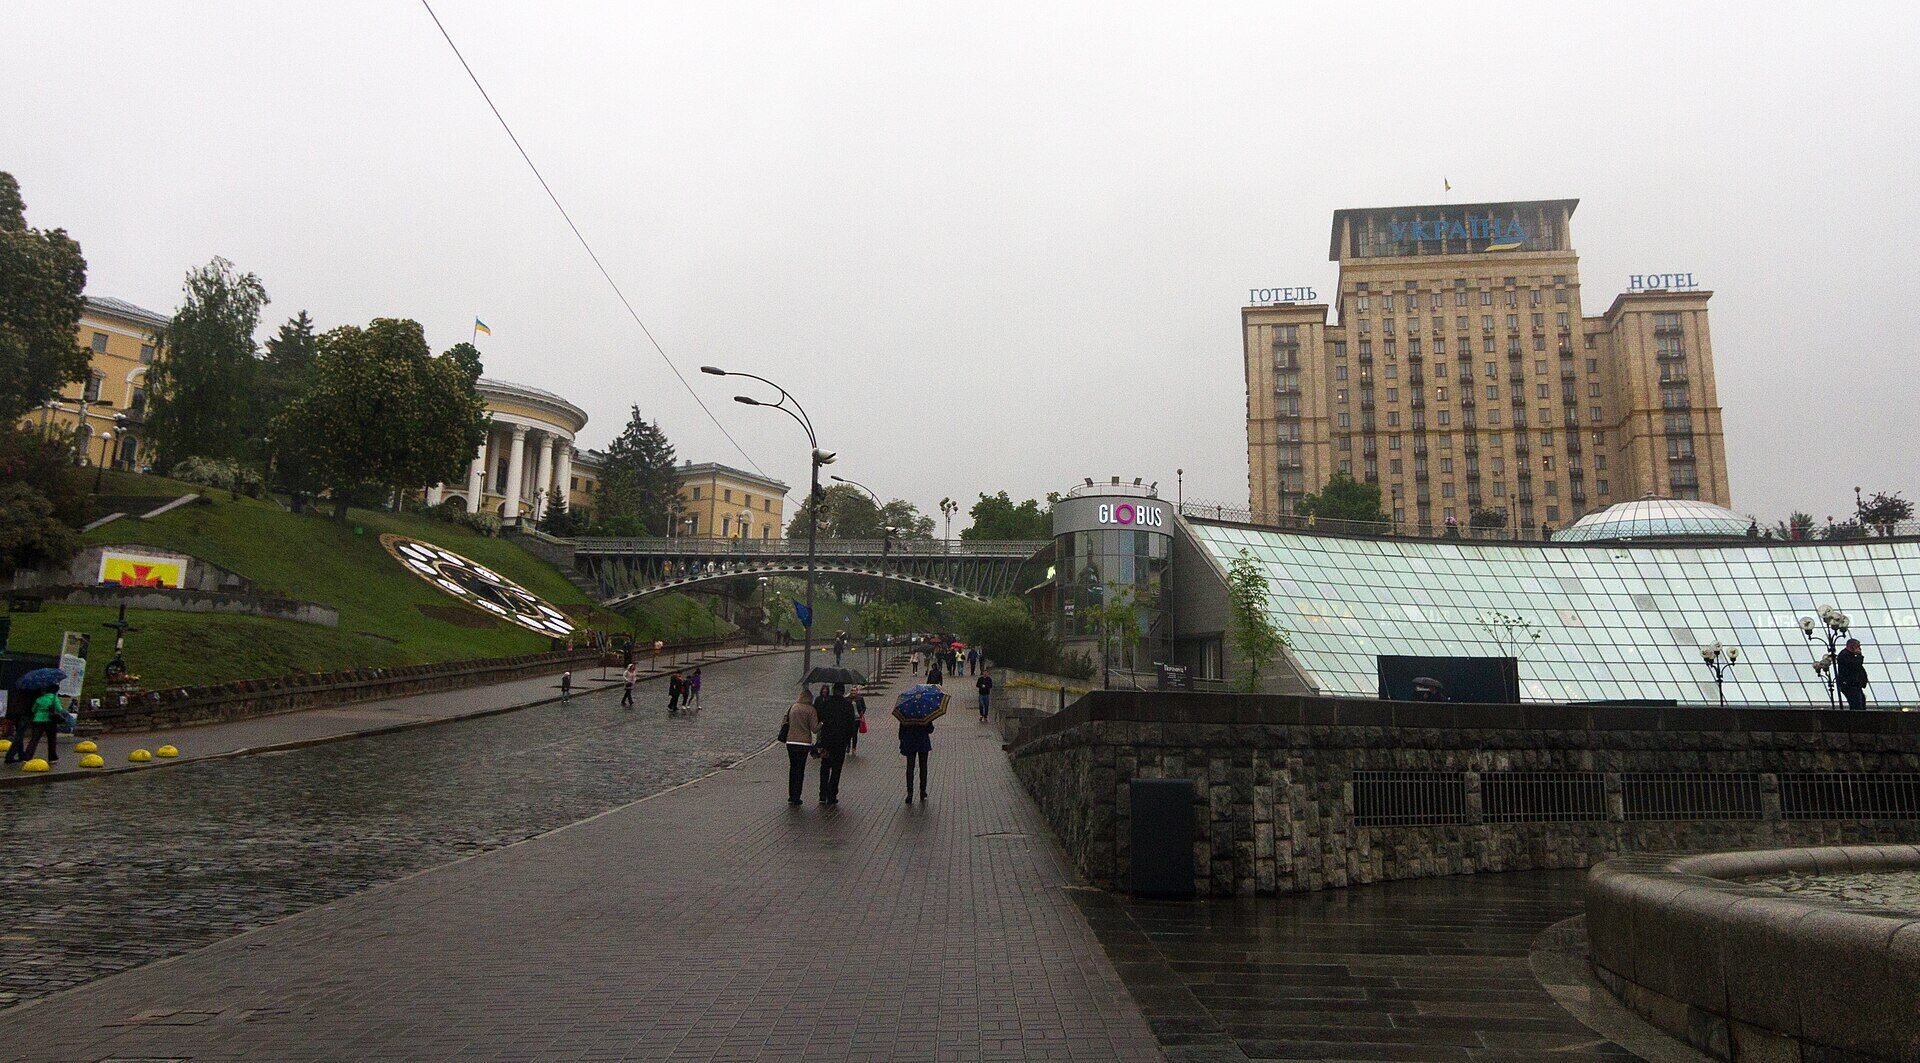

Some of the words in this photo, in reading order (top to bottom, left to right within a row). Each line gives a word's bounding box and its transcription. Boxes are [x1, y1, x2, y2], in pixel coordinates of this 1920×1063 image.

[1391, 216, 1525, 241] УКРАЇНА
[1629, 273, 1699, 289] HOTEL
[1249, 287, 1317, 302] ГОТЕЛЬ
[1099, 504, 1162, 527] GLOBUS
